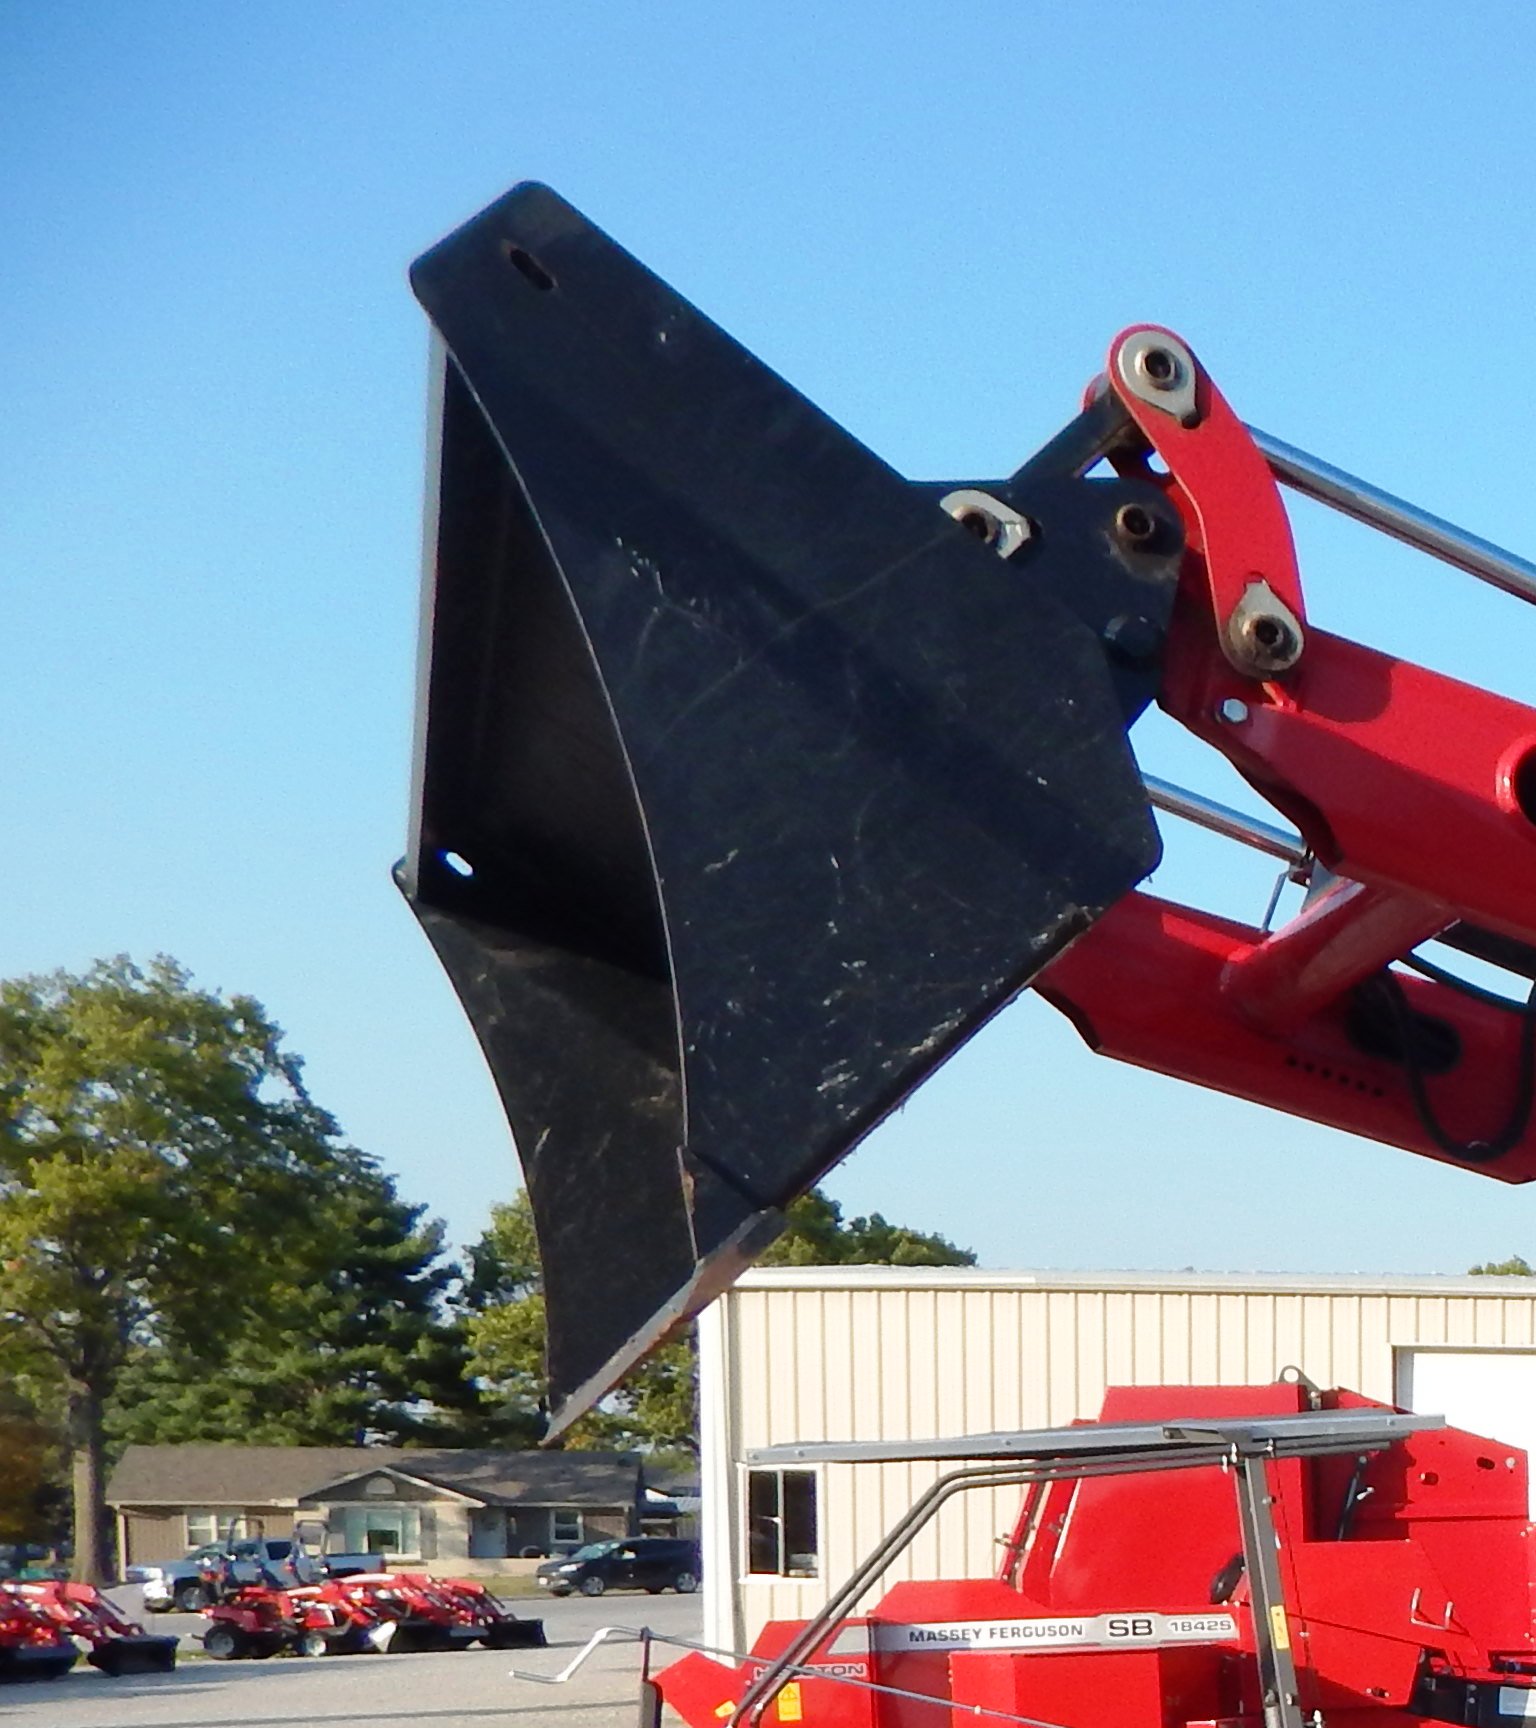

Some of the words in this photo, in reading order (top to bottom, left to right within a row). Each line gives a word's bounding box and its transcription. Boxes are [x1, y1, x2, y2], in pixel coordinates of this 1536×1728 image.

[909, 1628, 981, 1643] MASSEY
[990, 1624, 1083, 1639] FERGUSON
[1108, 1619, 1152, 1637] SB
